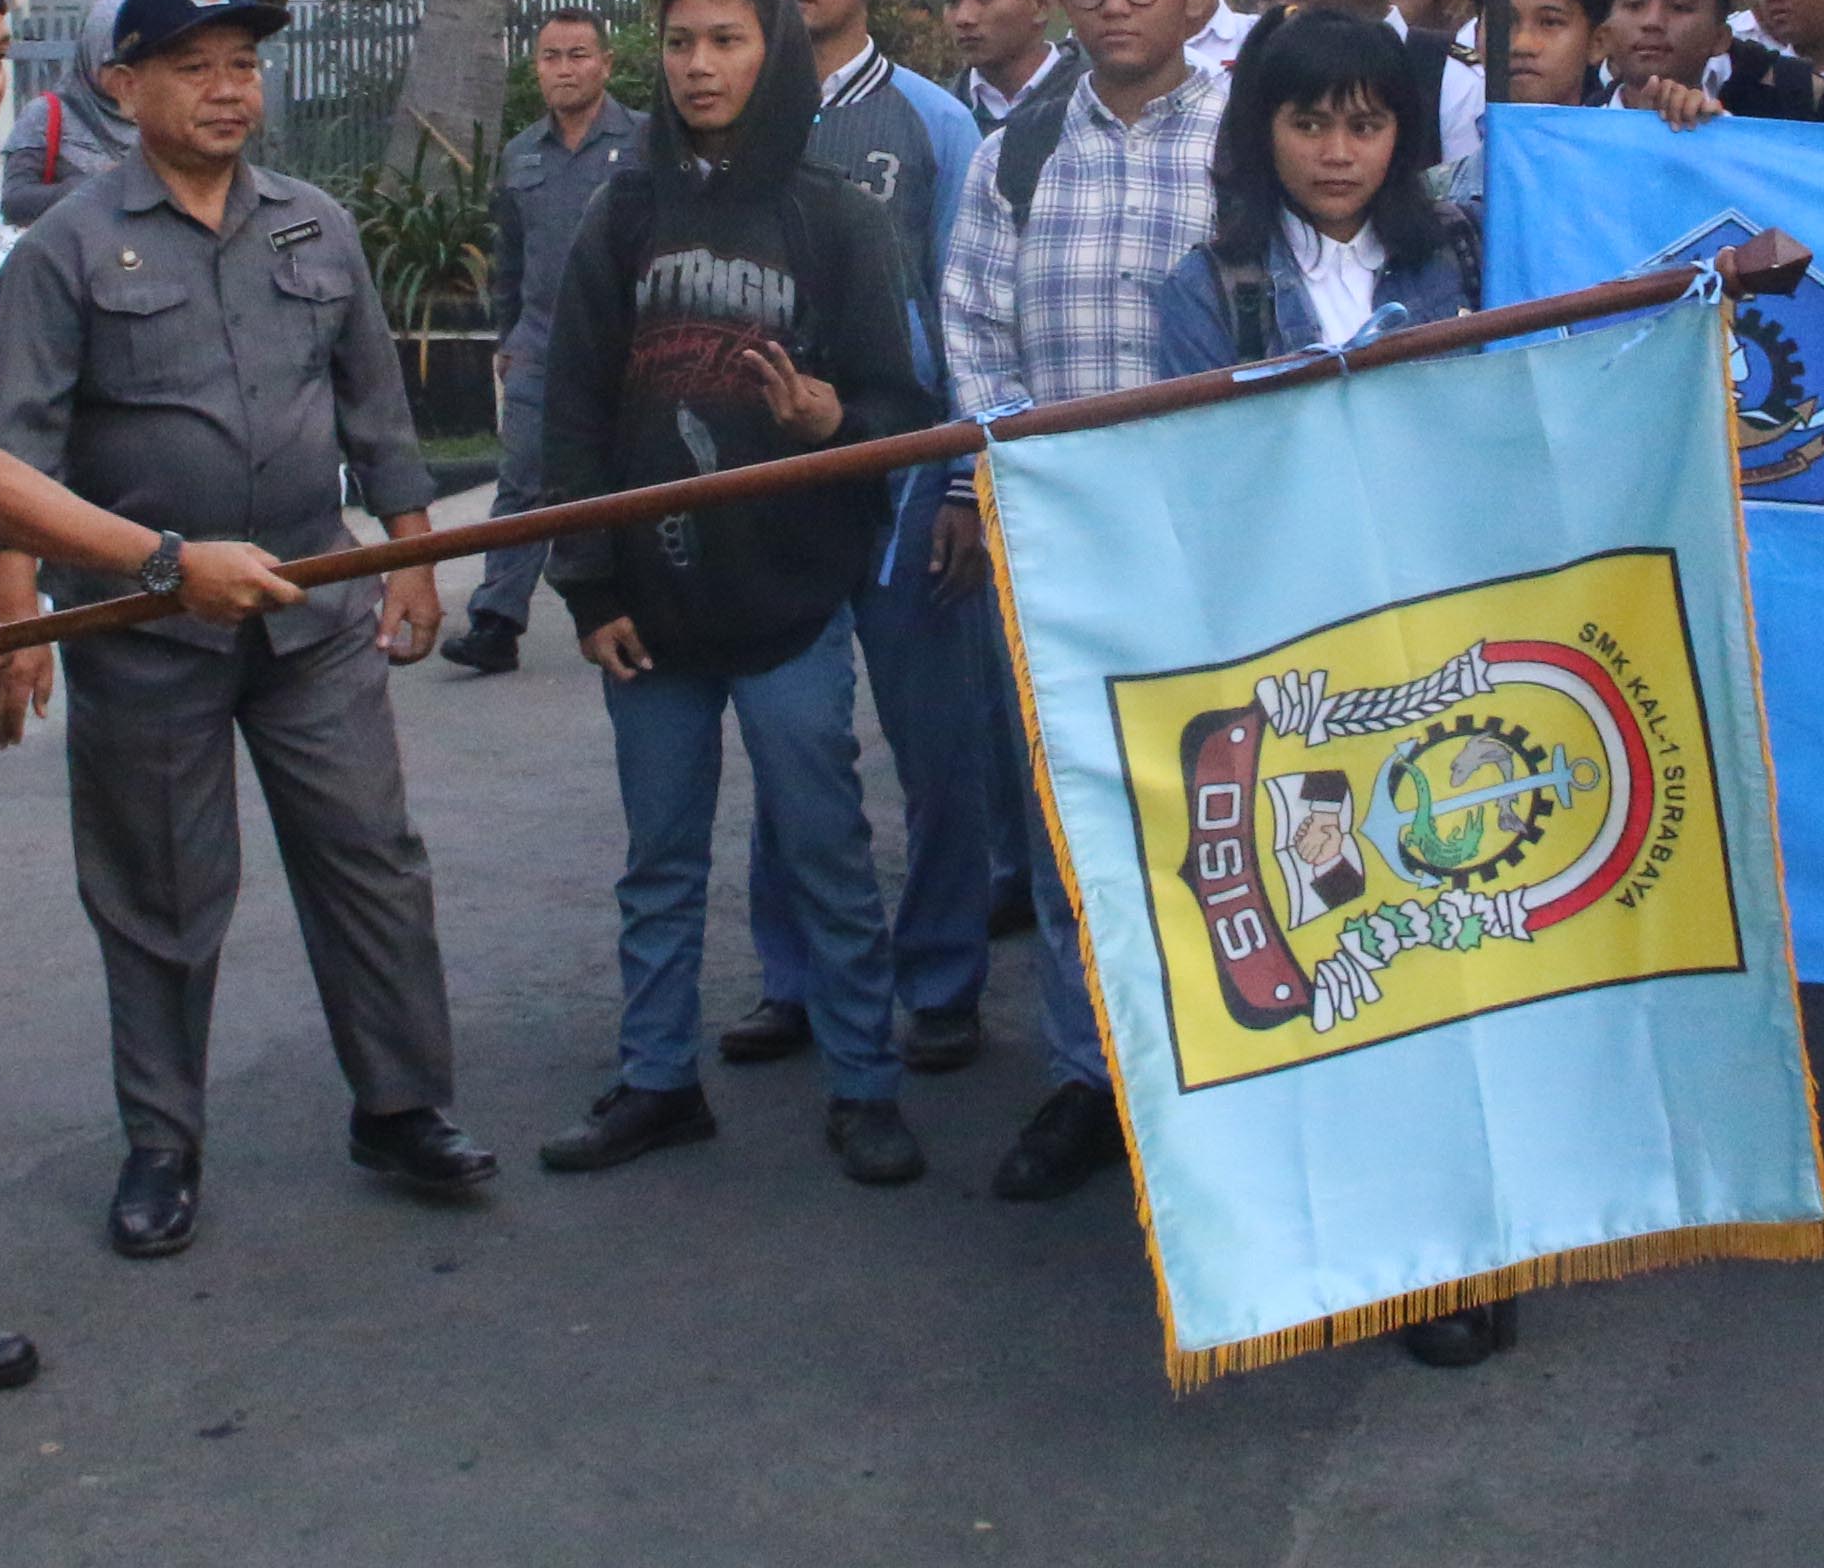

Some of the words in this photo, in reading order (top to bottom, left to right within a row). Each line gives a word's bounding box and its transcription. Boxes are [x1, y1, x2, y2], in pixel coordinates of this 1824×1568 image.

[1578, 621, 1631, 675] SMK
[1626, 675, 1681, 756] KAL-1
[1196, 781, 1268, 961] OSIS
[1614, 764, 1686, 910] SURABAYA
